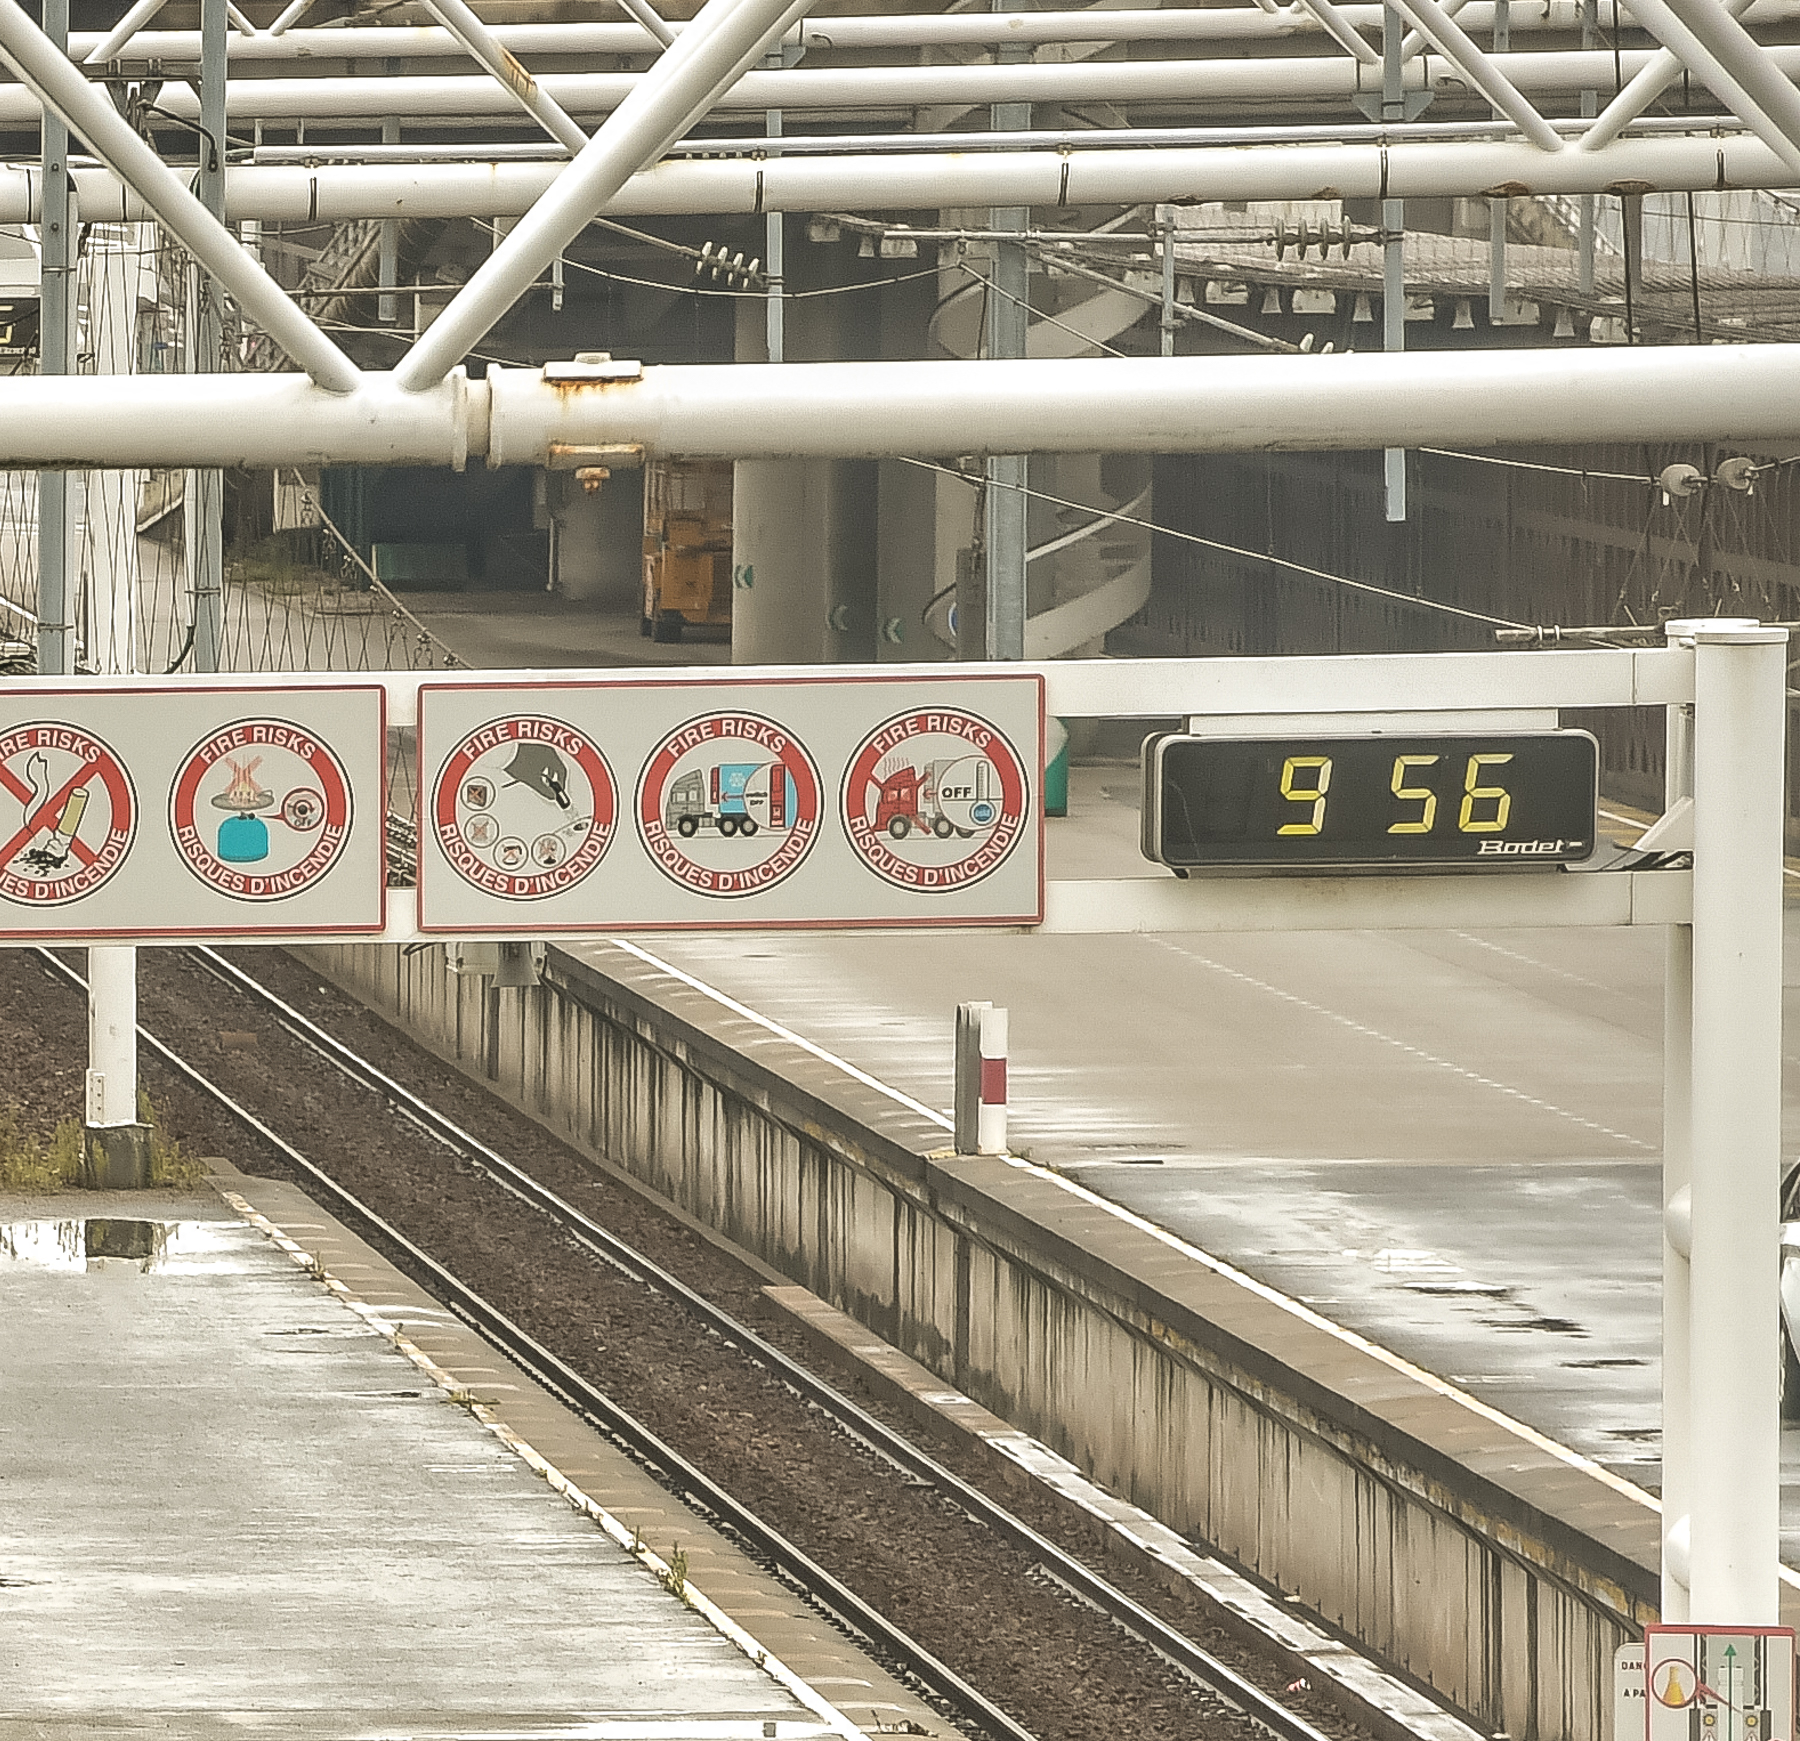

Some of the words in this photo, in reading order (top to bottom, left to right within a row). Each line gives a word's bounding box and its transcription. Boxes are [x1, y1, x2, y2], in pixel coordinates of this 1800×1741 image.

[37, 730, 100, 763] RISKS
[200, 729, 246, 764] FIRE
[253, 727, 316, 759] RISKS
[462, 723, 511, 760] FIRE
[518, 721, 583, 755] RISKS
[667, 722, 715, 758] FIRE
[721, 719, 787, 753] RISKS
[872, 718, 920, 754] FIRE
[927, 715, 992, 748] RISKS
[942, 787, 972, 798] OFF
[1277, 756, 1332, 835] 9
[1387, 754, 1515, 833] 56
[35, 828, 128, 898] D'INCENDIE
[179, 825, 244, 891] RISQUES
[251, 824, 343, 894] D'INCENDIE
[440, 824, 509, 891] RISQUES
[515, 821, 610, 894] D'INCENDIE
[645, 820, 712, 887] RISQUES
[718, 818, 813, 890] D'INCENDIE
[850, 816, 918, 883] RISQUES
[924, 813, 1018, 885] D'INCENDIE
[1477, 839, 1564, 855] Bodet
[1622, 1661, 1646, 1670] DAN
